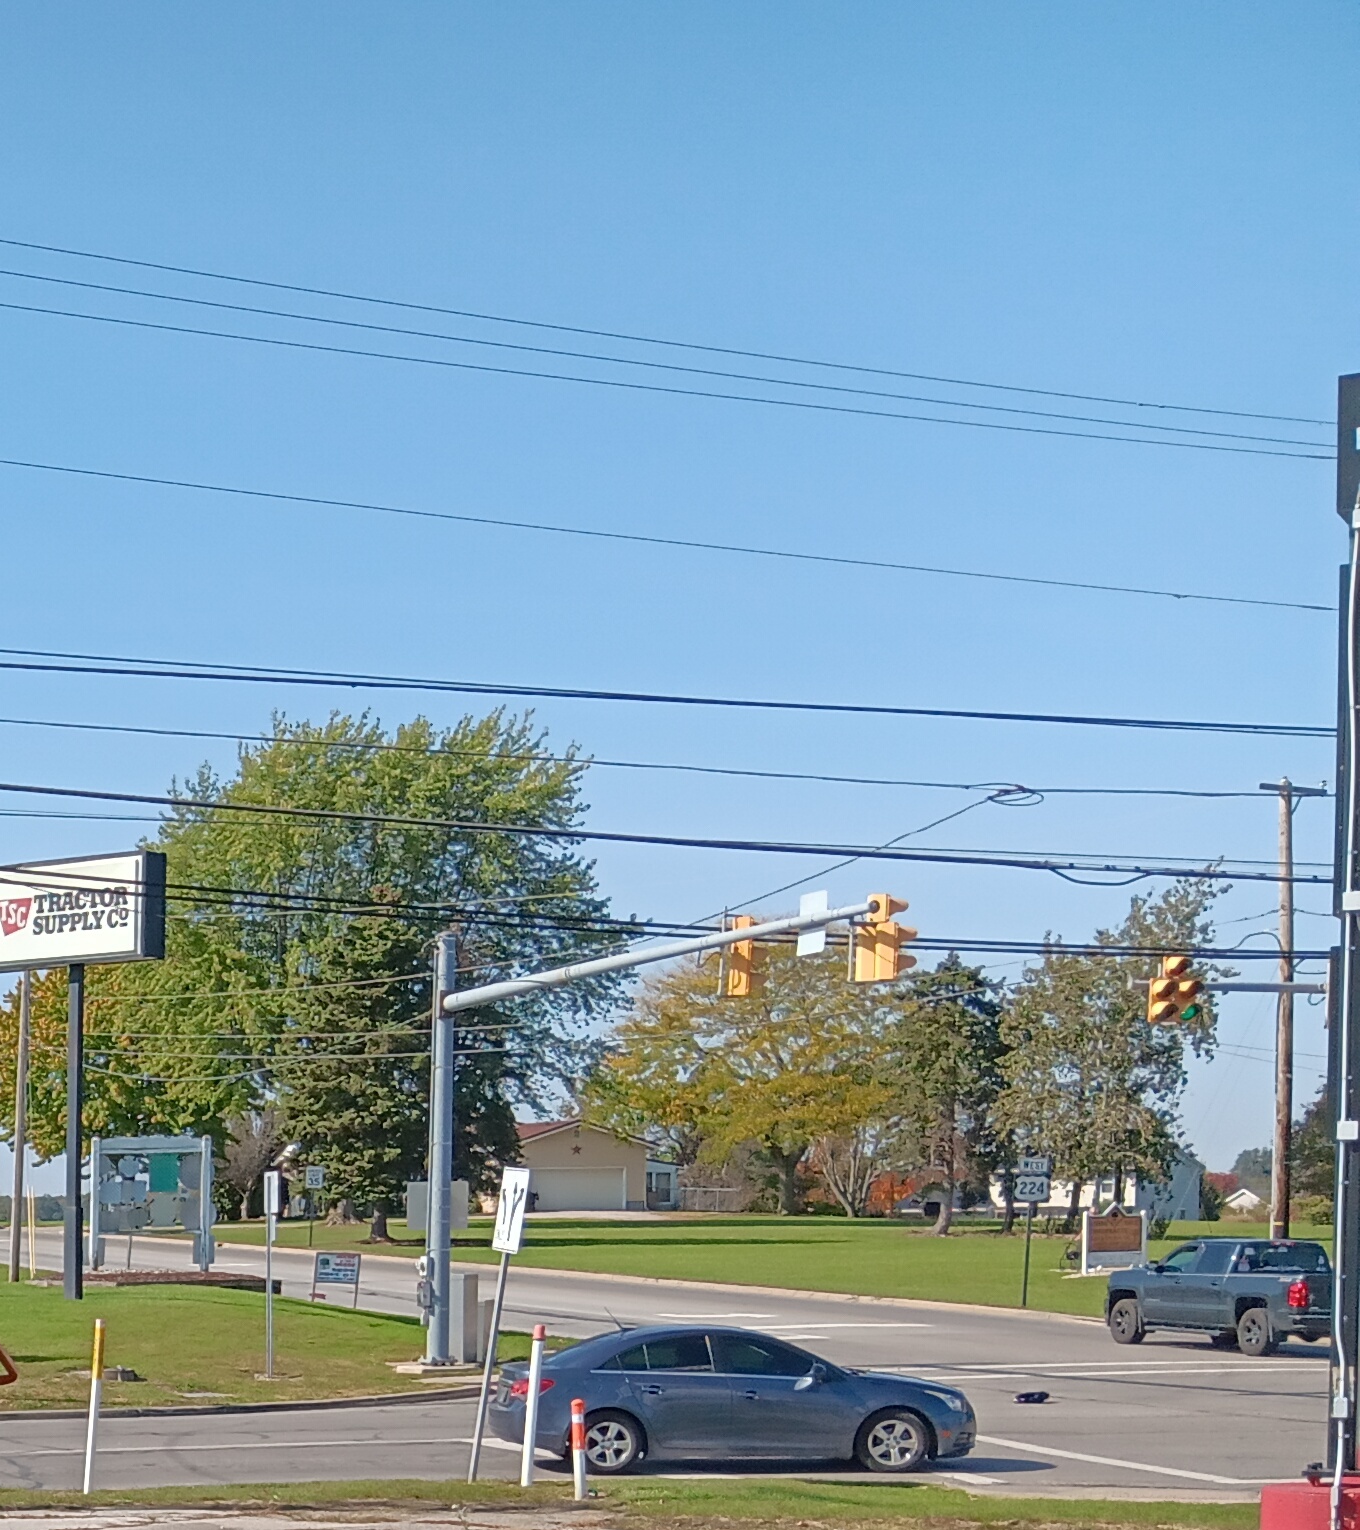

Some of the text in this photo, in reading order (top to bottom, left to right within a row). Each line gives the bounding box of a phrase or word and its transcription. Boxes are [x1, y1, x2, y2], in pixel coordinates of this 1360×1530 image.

[33, 887, 128, 914] TRACTOR
[0, 901, 26, 928] TSC
[32, 910, 103, 935] SUPPLY
[1023, 1160, 1045, 1170] WEST
[1019, 1181, 1045, 1195] 224
